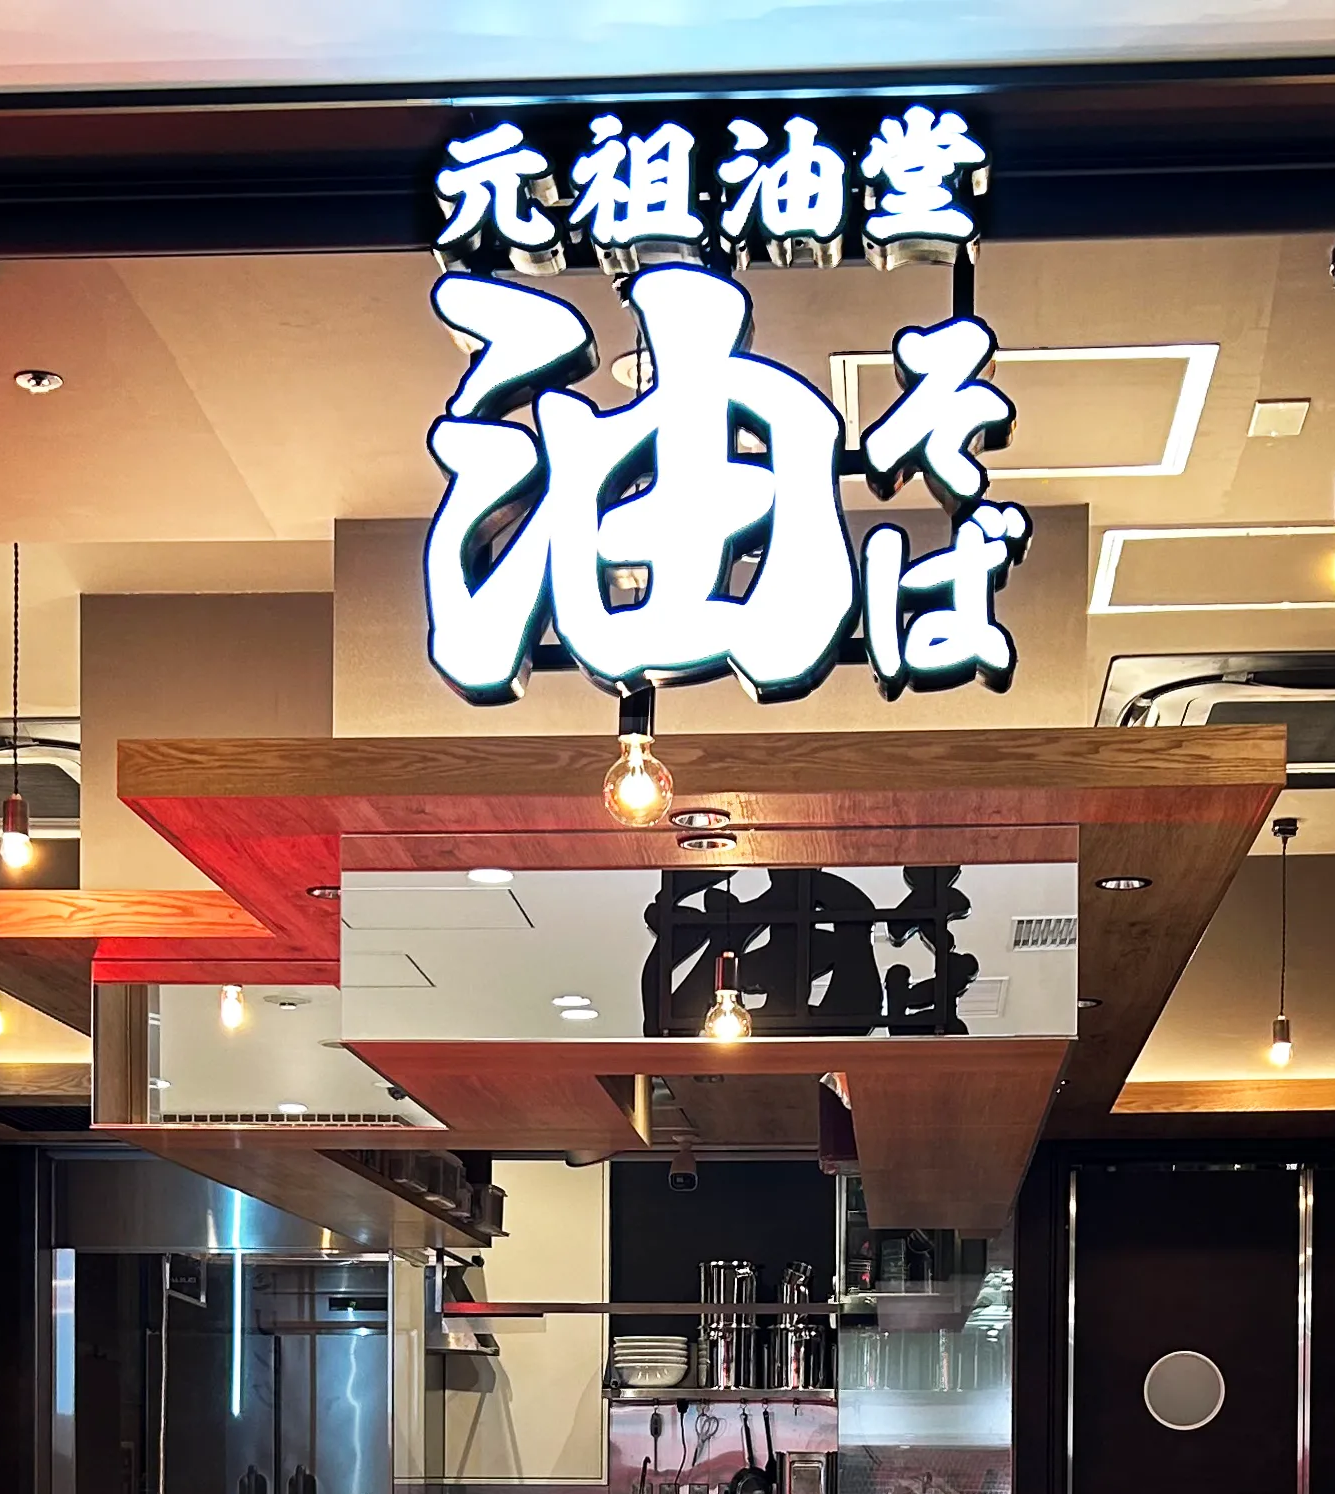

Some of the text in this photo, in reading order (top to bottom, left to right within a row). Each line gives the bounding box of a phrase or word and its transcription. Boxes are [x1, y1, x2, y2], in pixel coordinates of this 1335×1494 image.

[433, 104, 988, 247] 元祖油堂
[426, 262, 1027, 695] 油そば
